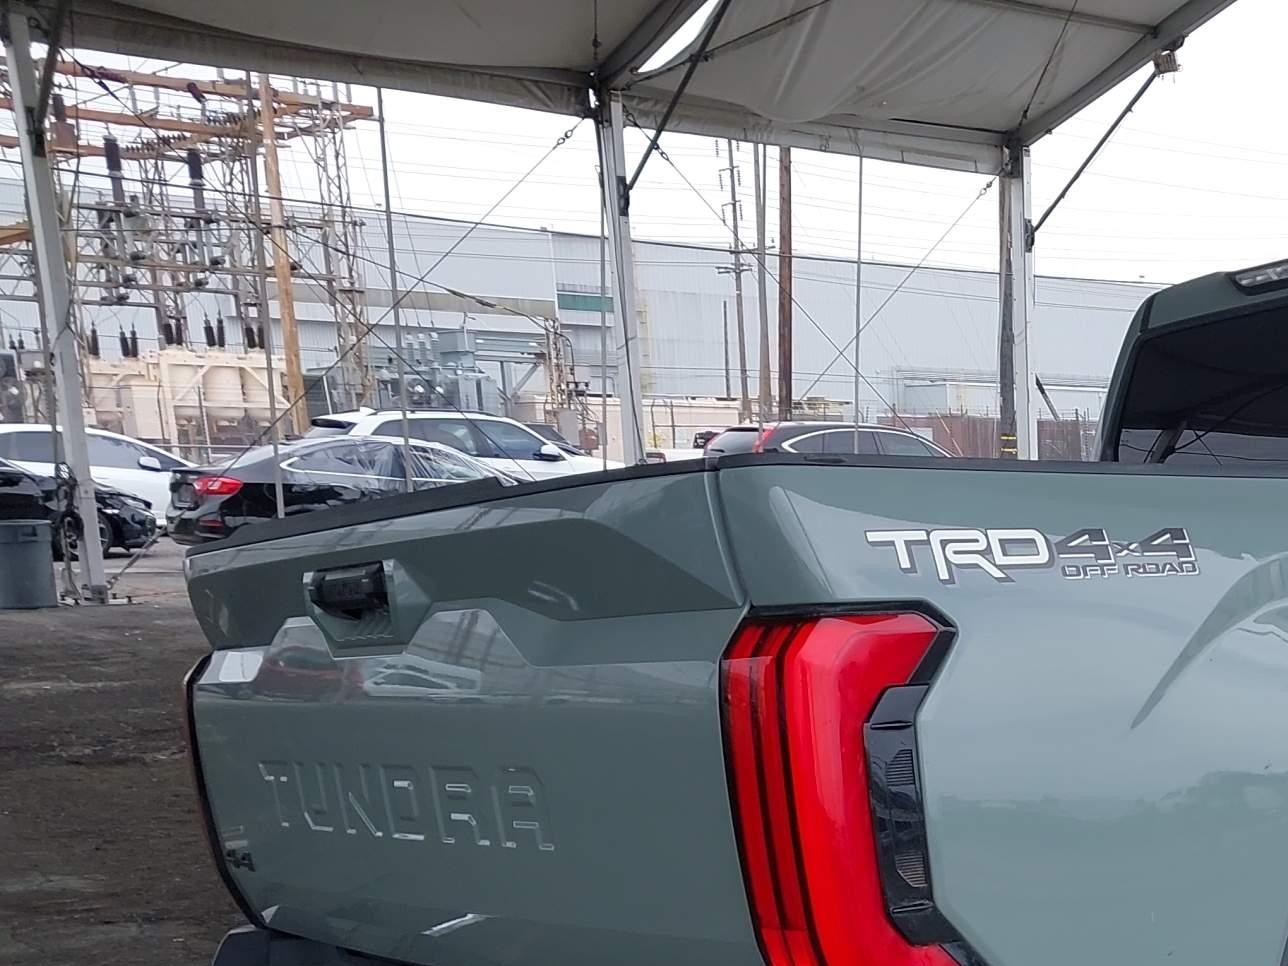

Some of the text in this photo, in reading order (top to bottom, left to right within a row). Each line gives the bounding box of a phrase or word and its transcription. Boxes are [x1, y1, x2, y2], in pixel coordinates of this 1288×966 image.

[864, 527, 1200, 585] TRD 4x4
[1061, 561, 1200, 579] OFF ROAD
[257, 760, 555, 850] TUNDRA
